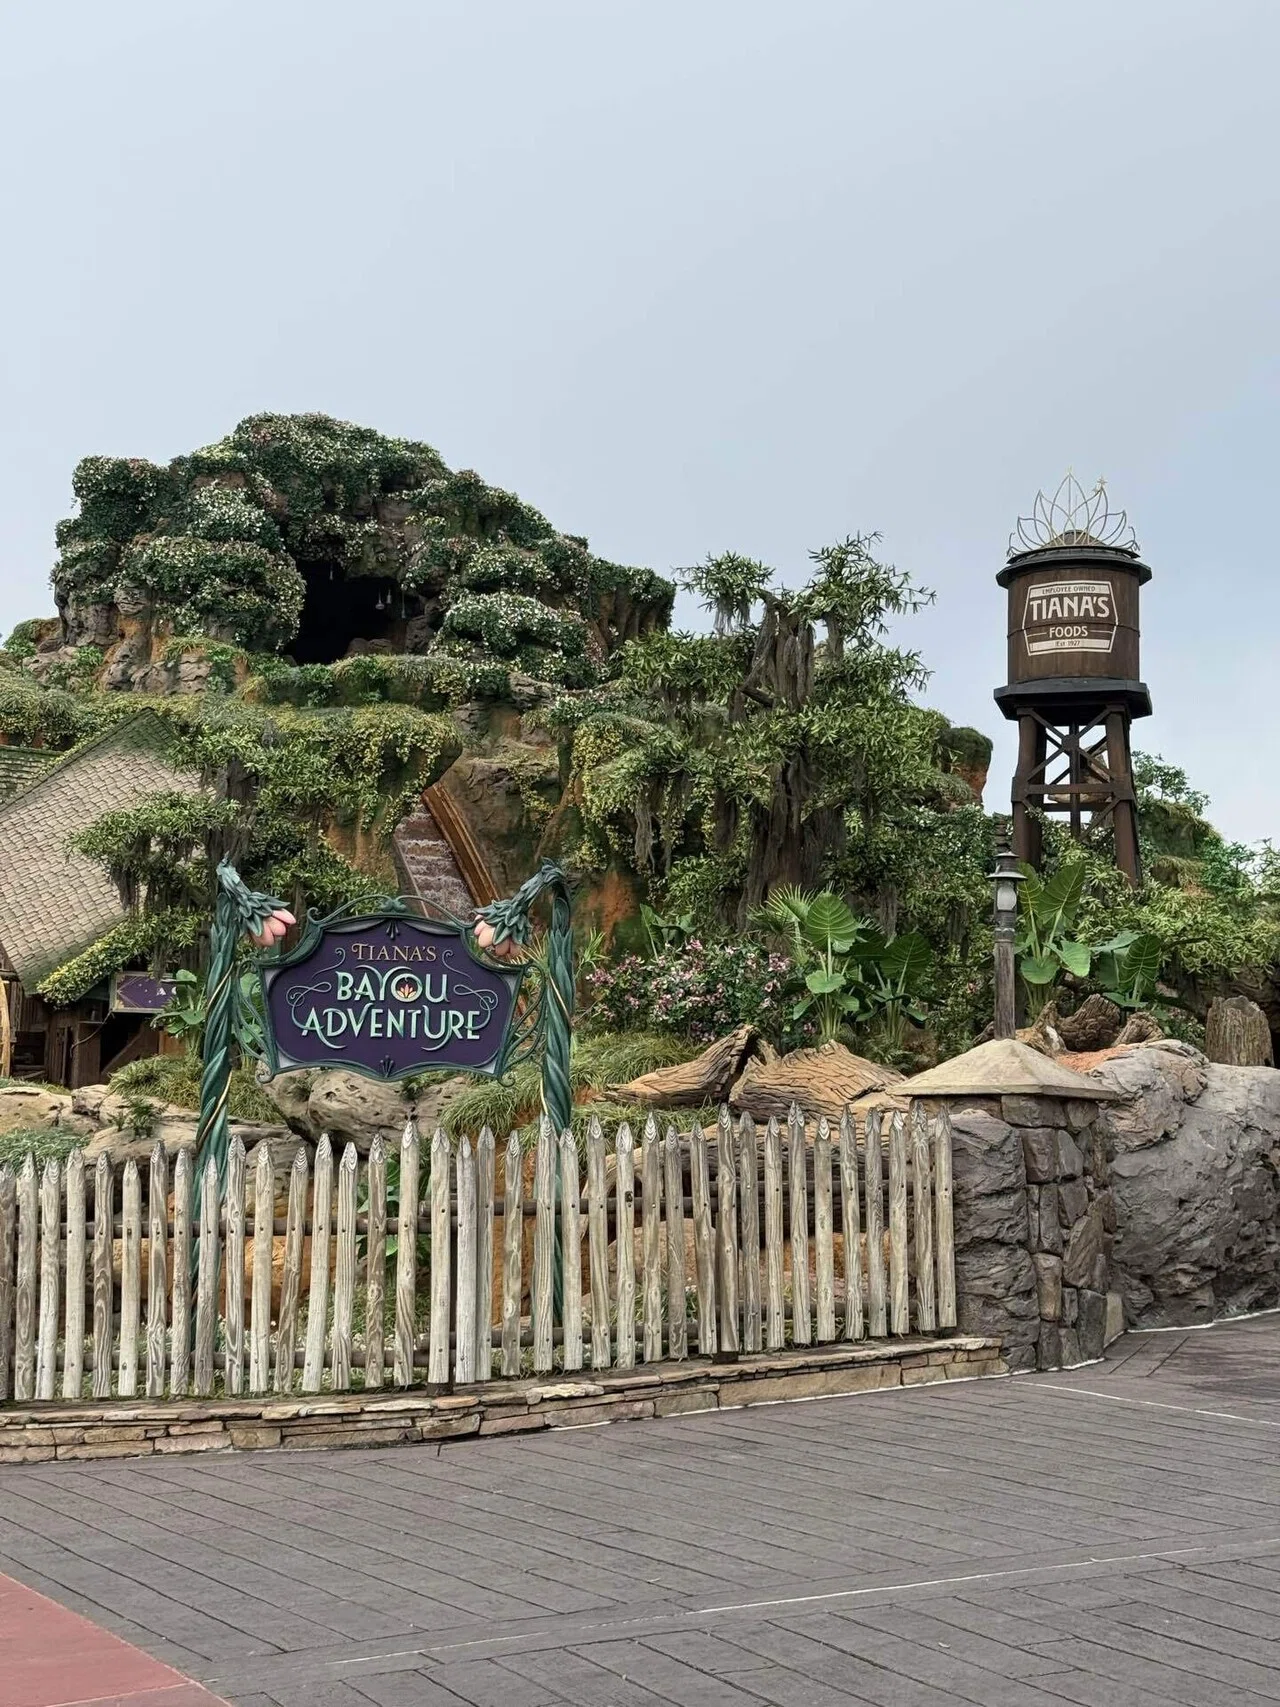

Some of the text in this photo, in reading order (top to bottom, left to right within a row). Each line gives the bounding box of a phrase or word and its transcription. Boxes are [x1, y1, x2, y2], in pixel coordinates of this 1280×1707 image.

[1042, 586, 1071, 595] EMPLOYEE
[1030, 595, 1110, 621] TIANA'S
[1049, 625, 1089, 638] FOODS
[351, 943, 437, 962] TIANA'S
[335, 964, 450, 1003] BAYOU
[301, 1002, 481, 1051] ADVENTURE
